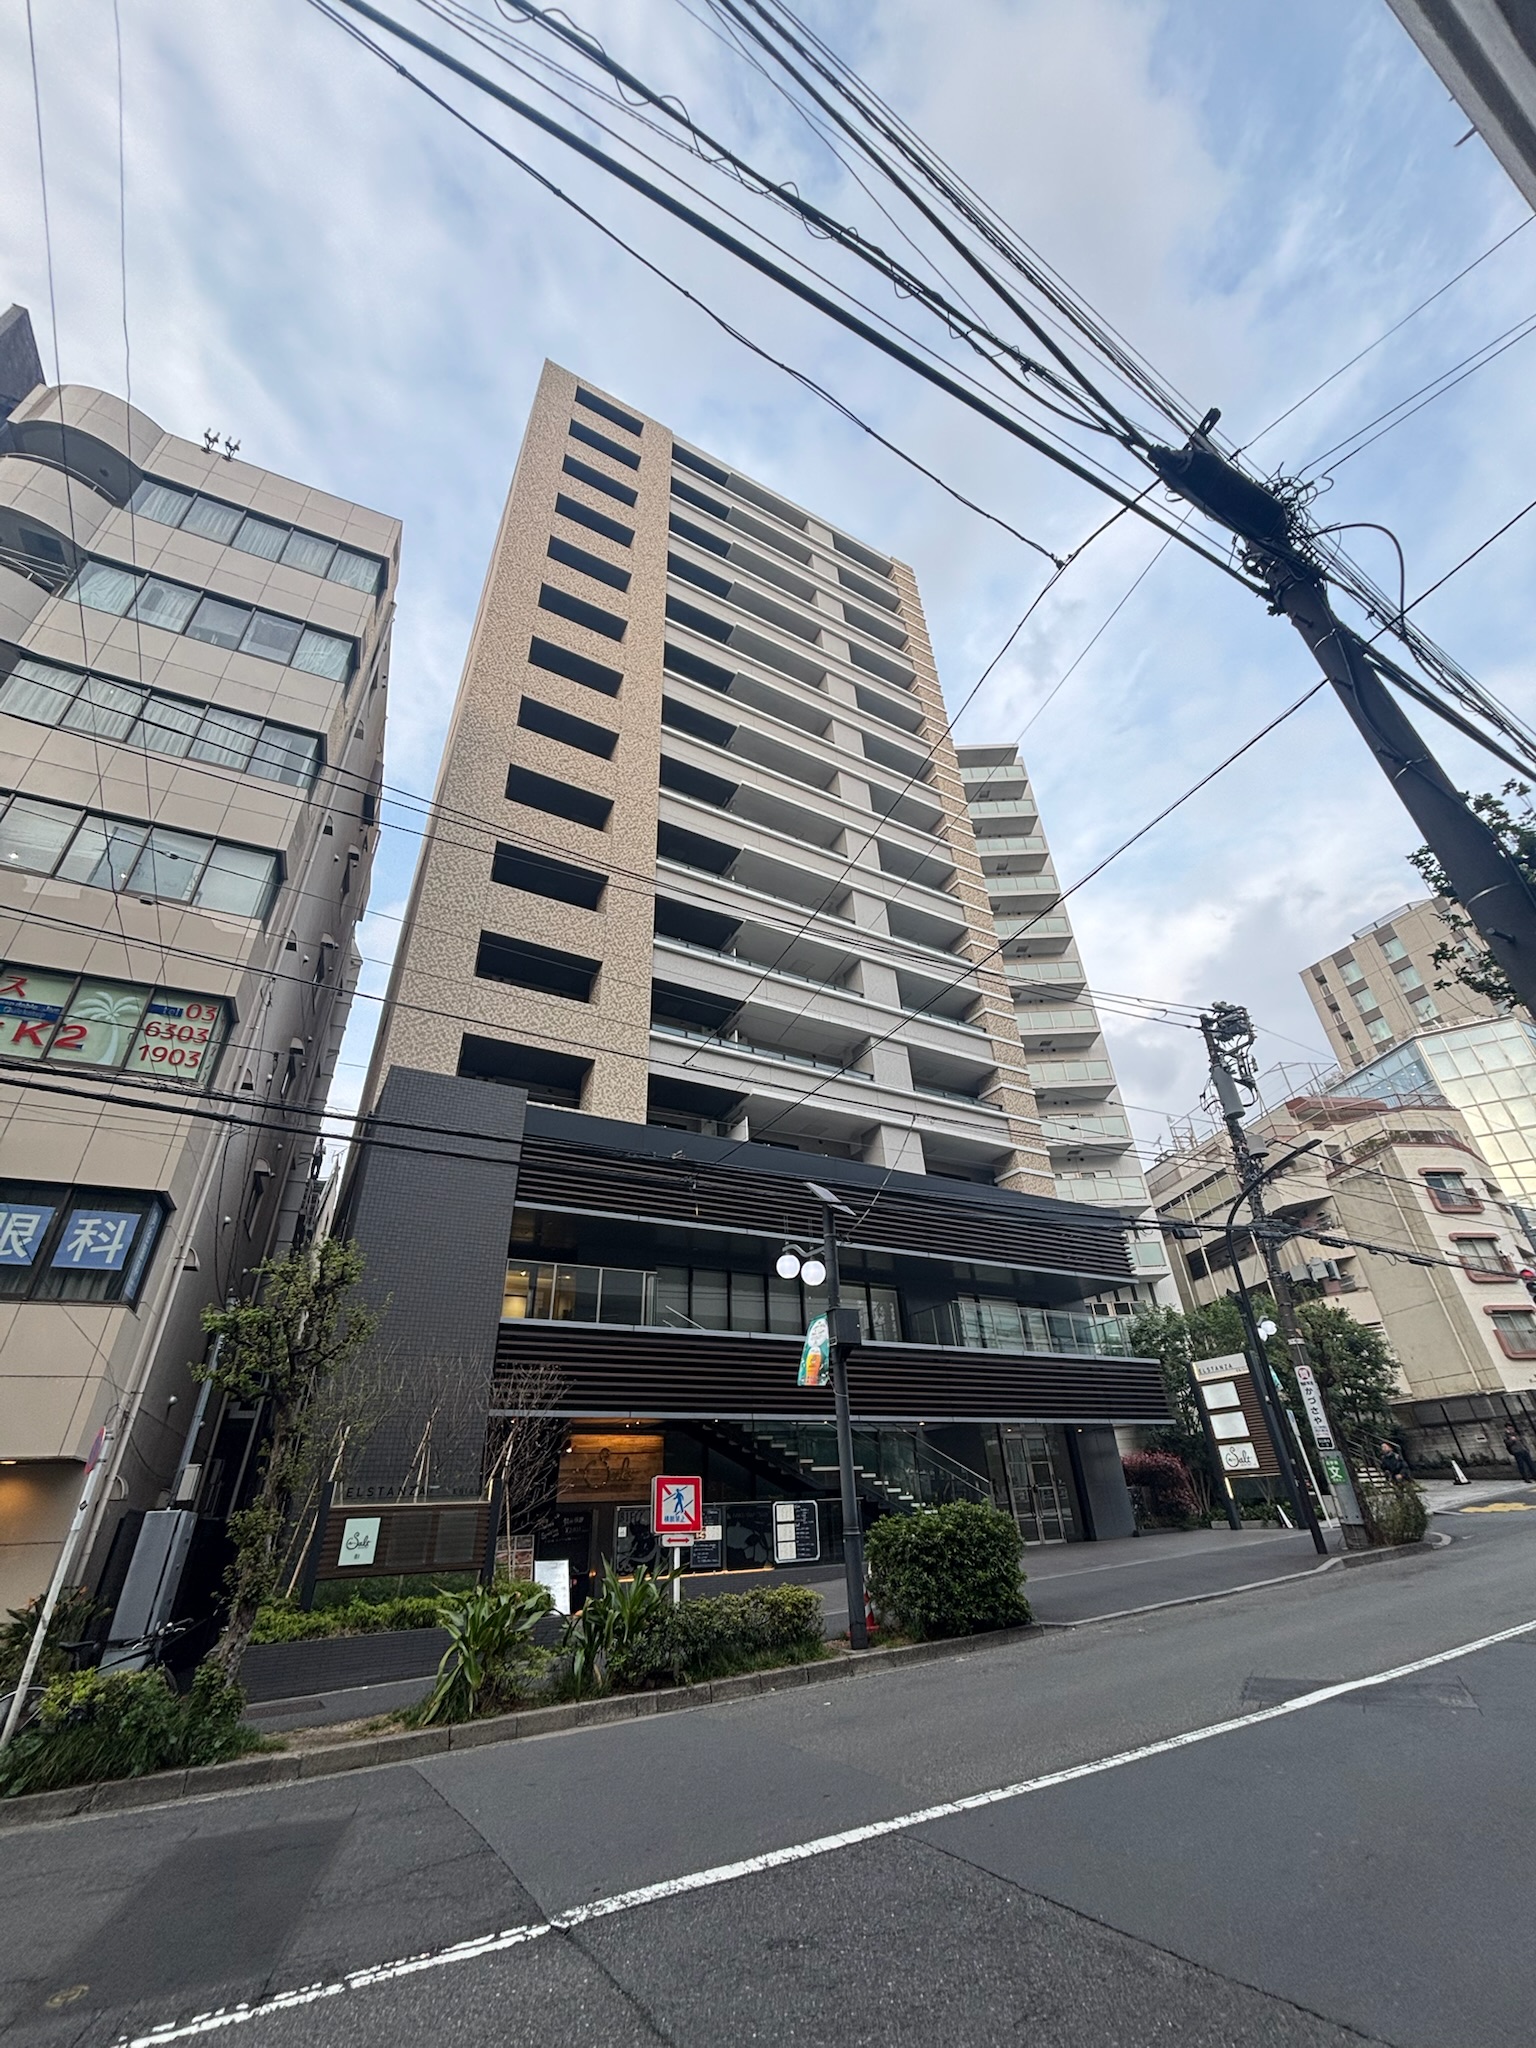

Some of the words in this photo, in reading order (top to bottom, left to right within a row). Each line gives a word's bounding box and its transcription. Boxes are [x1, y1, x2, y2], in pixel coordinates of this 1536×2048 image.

[0, 975, 28, 998] ス
[162, 1006, 180, 1016] tel
[185, 1003, 218, 1022] 03
[144, 1021, 209, 1044] 6303
[139, 1044, 202, 1068] 1903
[1198, 1363, 1232, 1374] ELSTANZA
[1225, 1446, 1252, 1467] Salt
[1328, 1465, 1343, 1479] 文
[346, 1486, 427, 1498] ELSTANZA
